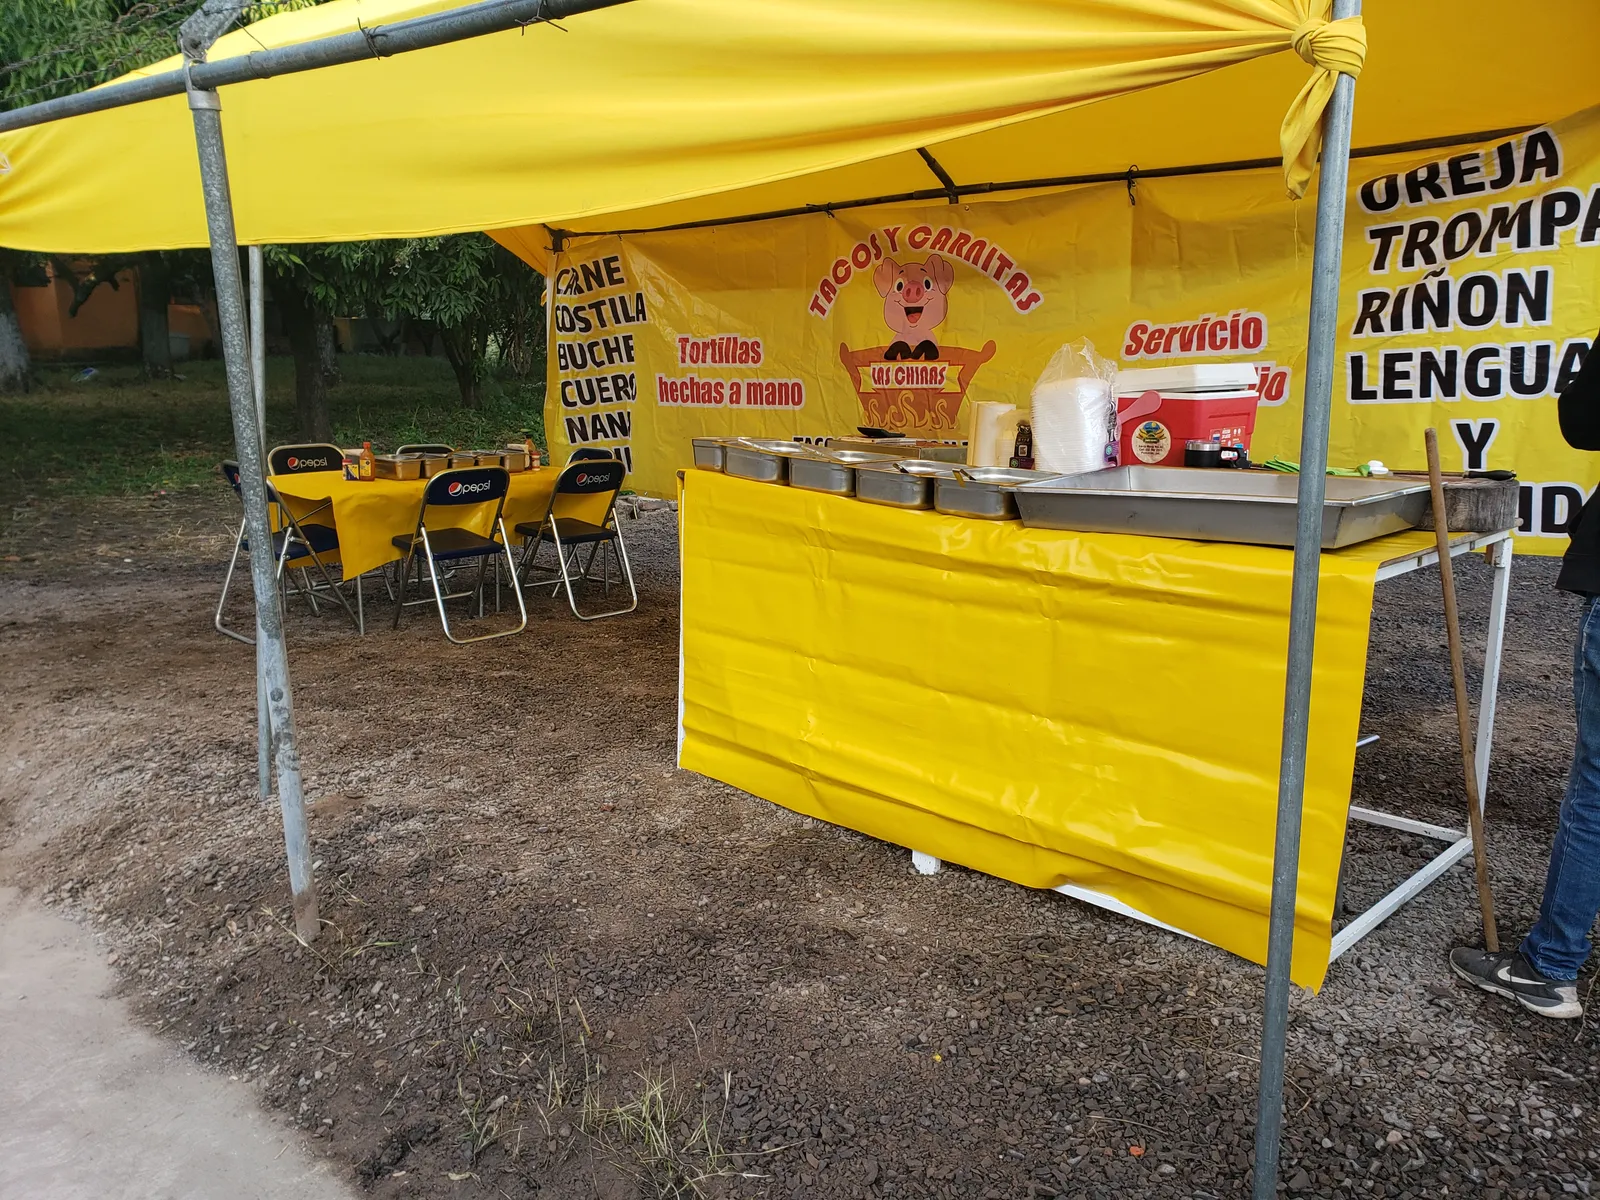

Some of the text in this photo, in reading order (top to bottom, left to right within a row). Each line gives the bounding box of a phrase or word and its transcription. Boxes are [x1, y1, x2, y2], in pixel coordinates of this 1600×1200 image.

[1361, 131, 1559, 211] OREJA
[556, 255, 625, 296] CARNE
[810, 226, 1041, 316] TACOS Y CARNITAS
[1353, 267, 1549, 335] RIÑON
[558, 334, 635, 371] BUCHE
[678, 337, 762, 364] Tortillas
[1124, 313, 1263, 356] Servicio
[871, 366, 890, 386] LAS
[1350, 342, 1592, 400] LENGUA
[561, 373, 637, 408] CUERO
[658, 376, 804, 406] hechas a mano
[565, 411, 631, 444] NAN
[1456, 422, 1496, 469] Y
[299, 457, 328, 469] pepsi
[587, 472, 611, 485] pepsi
[462, 480, 491, 495] pepsi
